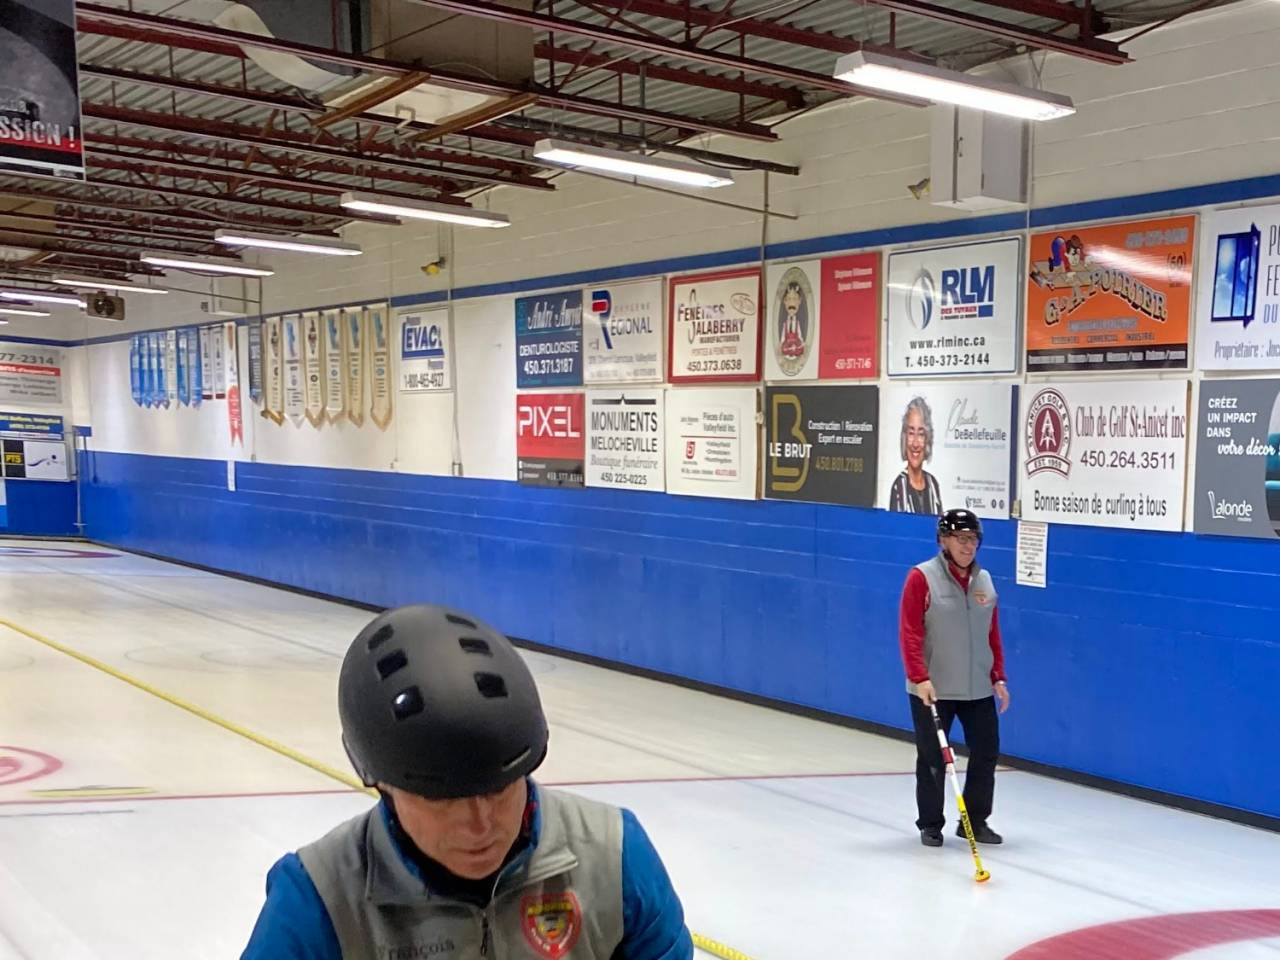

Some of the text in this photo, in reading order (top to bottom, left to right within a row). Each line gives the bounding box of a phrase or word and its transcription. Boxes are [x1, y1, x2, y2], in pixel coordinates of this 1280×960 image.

[941, 265, 995, 305] RLM
[1263, 303, 1278, 324] DU
[519, 341, 579, 357] DENTUROLOGISTE
[910, 336, 985, 349] www.rlminc.ca
[687, 359, 741, 372] 450.373.0638
[917, 353, 990, 367] 450-373-2144
[1208, 395, 1238, 409] CRÉEZ
[519, 406, 580, 437] PIXEL
[591, 411, 658, 432] MONUMENTS
[1075, 404, 1169, 439] Club de Golf St-Anicet
[1208, 412, 1257, 423] UN IMPACT
[1206, 427, 1231, 437] DANS
[591, 436, 658, 452] MELOCHEVILLE
[769, 443, 813, 459] LE BRUT
[1217, 438, 1244, 455] votre
[1080, 450, 1175, 470] 450.264.3511
[1034, 490, 1167, 521] Bonne saison de curling tous
[1208, 490, 1253, 519] Lalonde
